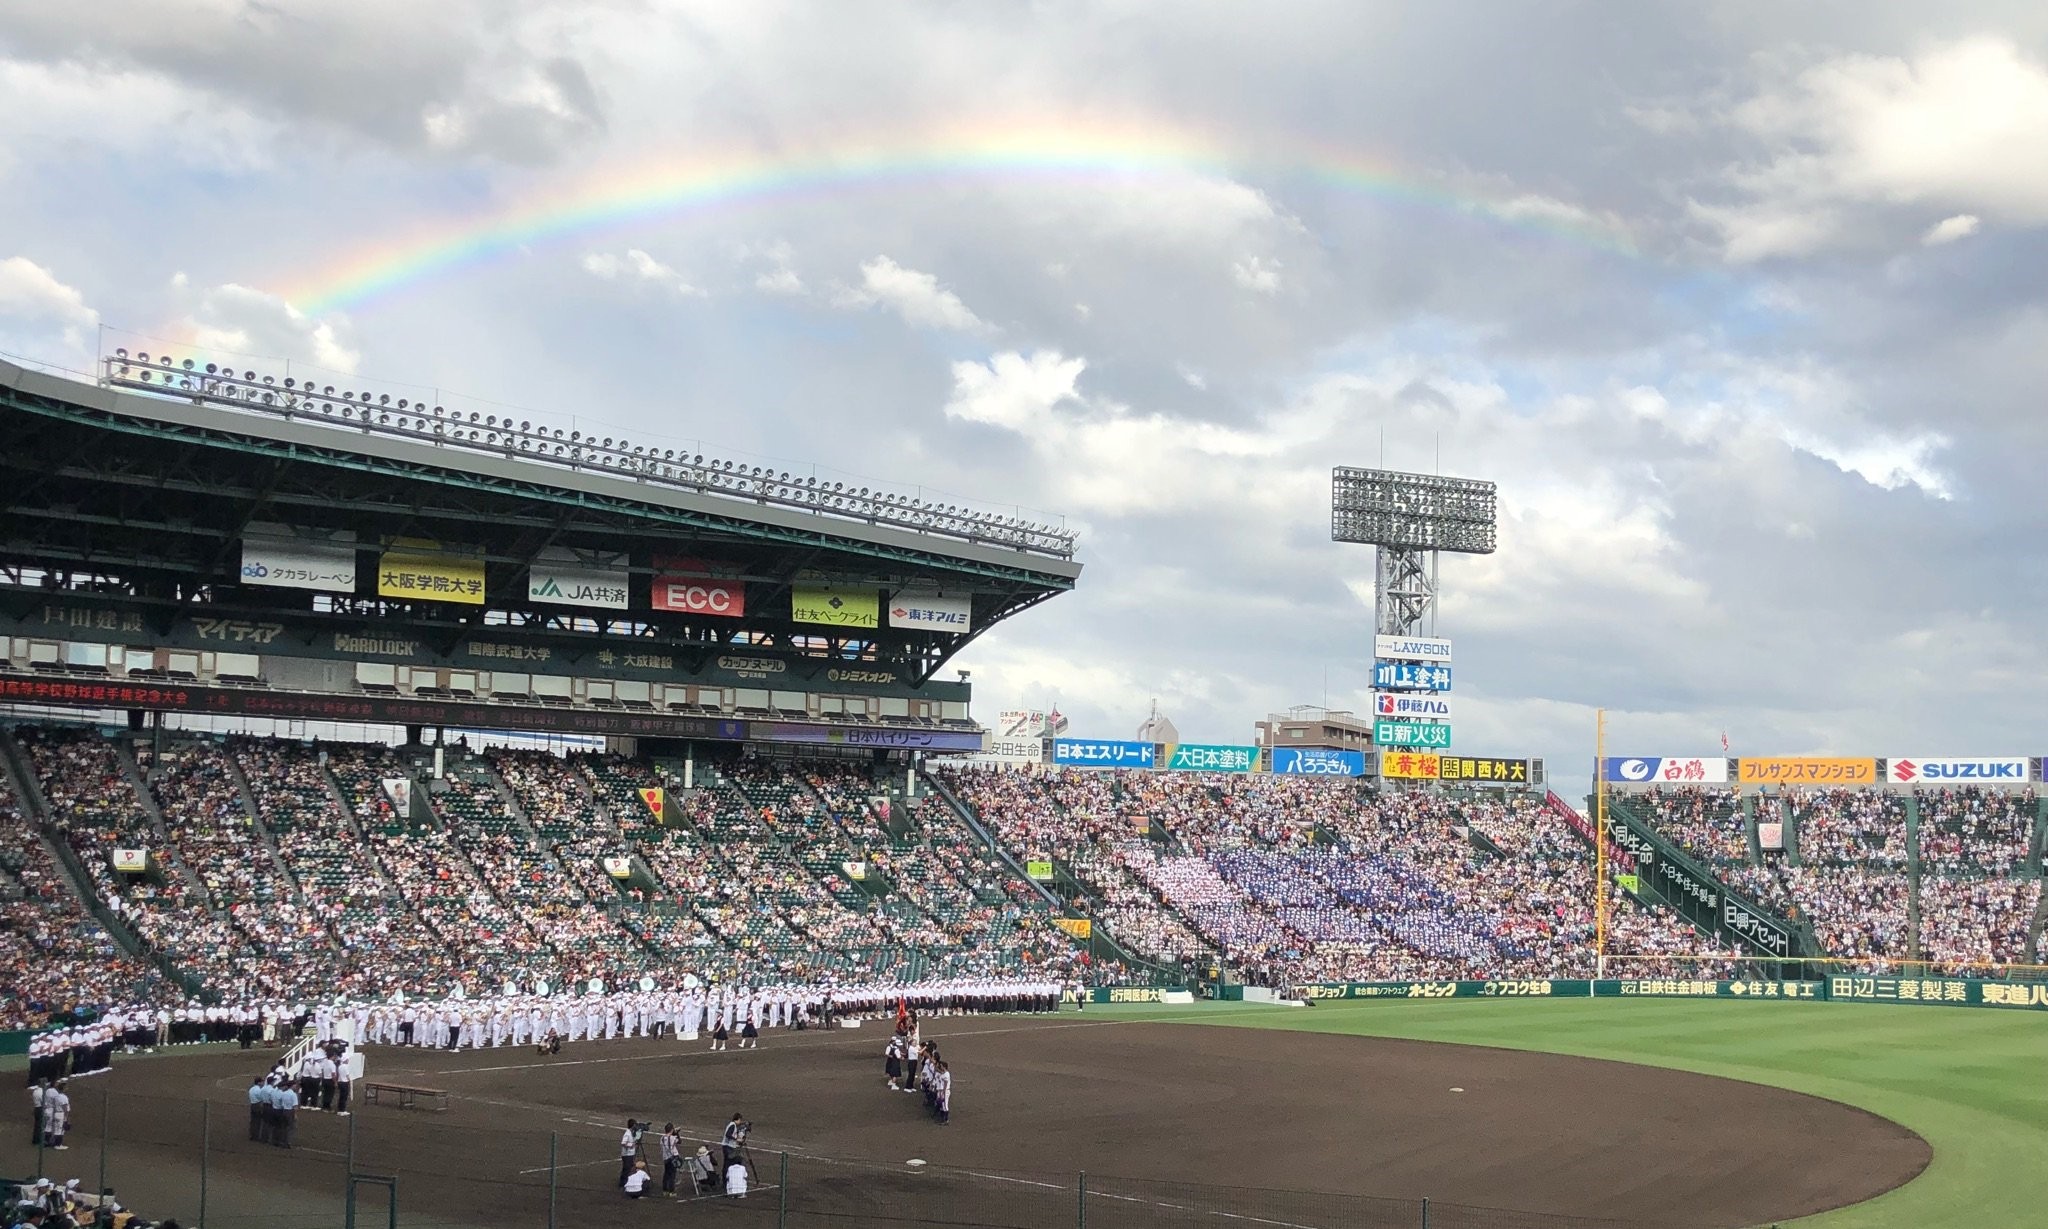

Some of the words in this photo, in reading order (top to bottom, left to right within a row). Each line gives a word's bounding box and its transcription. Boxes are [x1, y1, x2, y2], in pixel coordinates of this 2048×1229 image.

[272, 568, 355, 585] タカラレーベン
[382, 572, 482, 595] 大阪学院大学
[567, 585, 626, 604] JA共済
[667, 583, 730, 612] ECC
[794, 607, 879, 624] 住友ベークライト
[908, 608, 968, 625] 東洋アルミ
[191, 617, 284, 644] マイティア
[468, 642, 551, 661] 国際武道大学
[1393, 641, 1450, 656] LAWSON
[623, 653, 673, 670] 大成建設
[840, 669, 897, 684] シミズオクト
[1377, 665, 1450, 690] 川上塗料
[0, 680, 188, 704] 高等学校野球選手権記念大会
[1397, 699, 1449, 714] 伊藤ハム
[1379, 724, 1447, 745] 日新火災
[1057, 743, 1153, 763] 日本エスリード
[1176, 747, 1250, 770] 大日本塗料
[1304, 758, 1351, 775] ろうきん
[1396, 754, 1438, 777] 黄桜
[1461, 759, 1525, 780] 関西外大
[1664, 759, 1706, 781] 白鶴
[1745, 763, 1868, 779] プレサンスマンション
[1922, 762, 2023, 778] SUZUKI
[1603, 815, 1654, 865] 大同生命
[1660, 861, 1717, 908] 大日本住友製薬
[1726, 906, 1786, 953] 日興アセット
[1407, 982, 1457, 997] オービック
[1498, 980, 1552, 995] フコク生命
[1639, 981, 1717, 995] 日鉄住金鋼板
[1748, 981, 1815, 997] 住友電工
[1832, 977, 1967, 1001] 田辺三菱製薬
